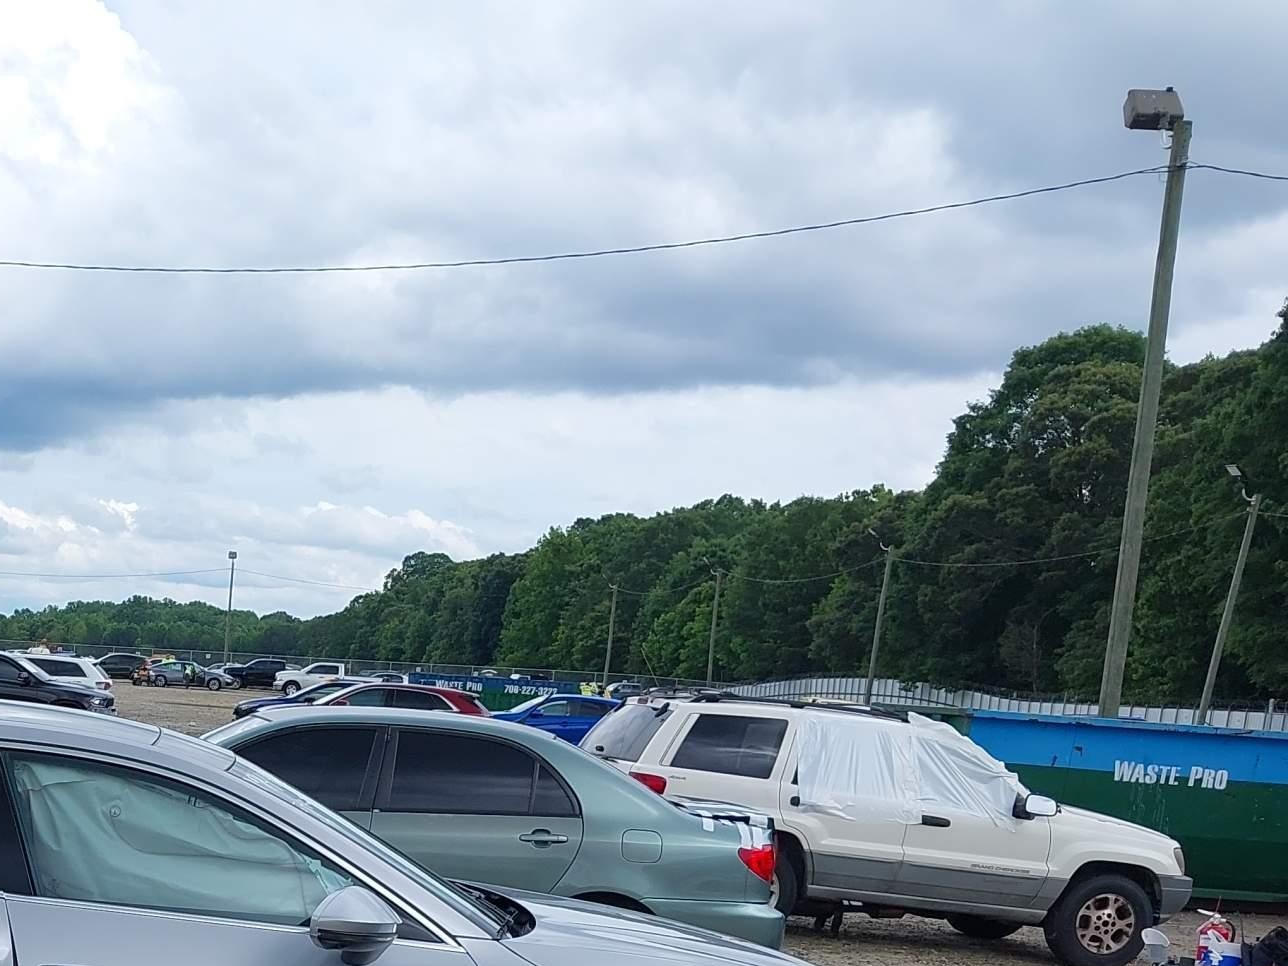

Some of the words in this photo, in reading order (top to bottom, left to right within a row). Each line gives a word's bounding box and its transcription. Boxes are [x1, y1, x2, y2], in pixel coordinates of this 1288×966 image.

[466, 681, 483, 692] PRO
[1114, 760, 1182, 785] WASTE
[1188, 766, 1229, 790] PRO
